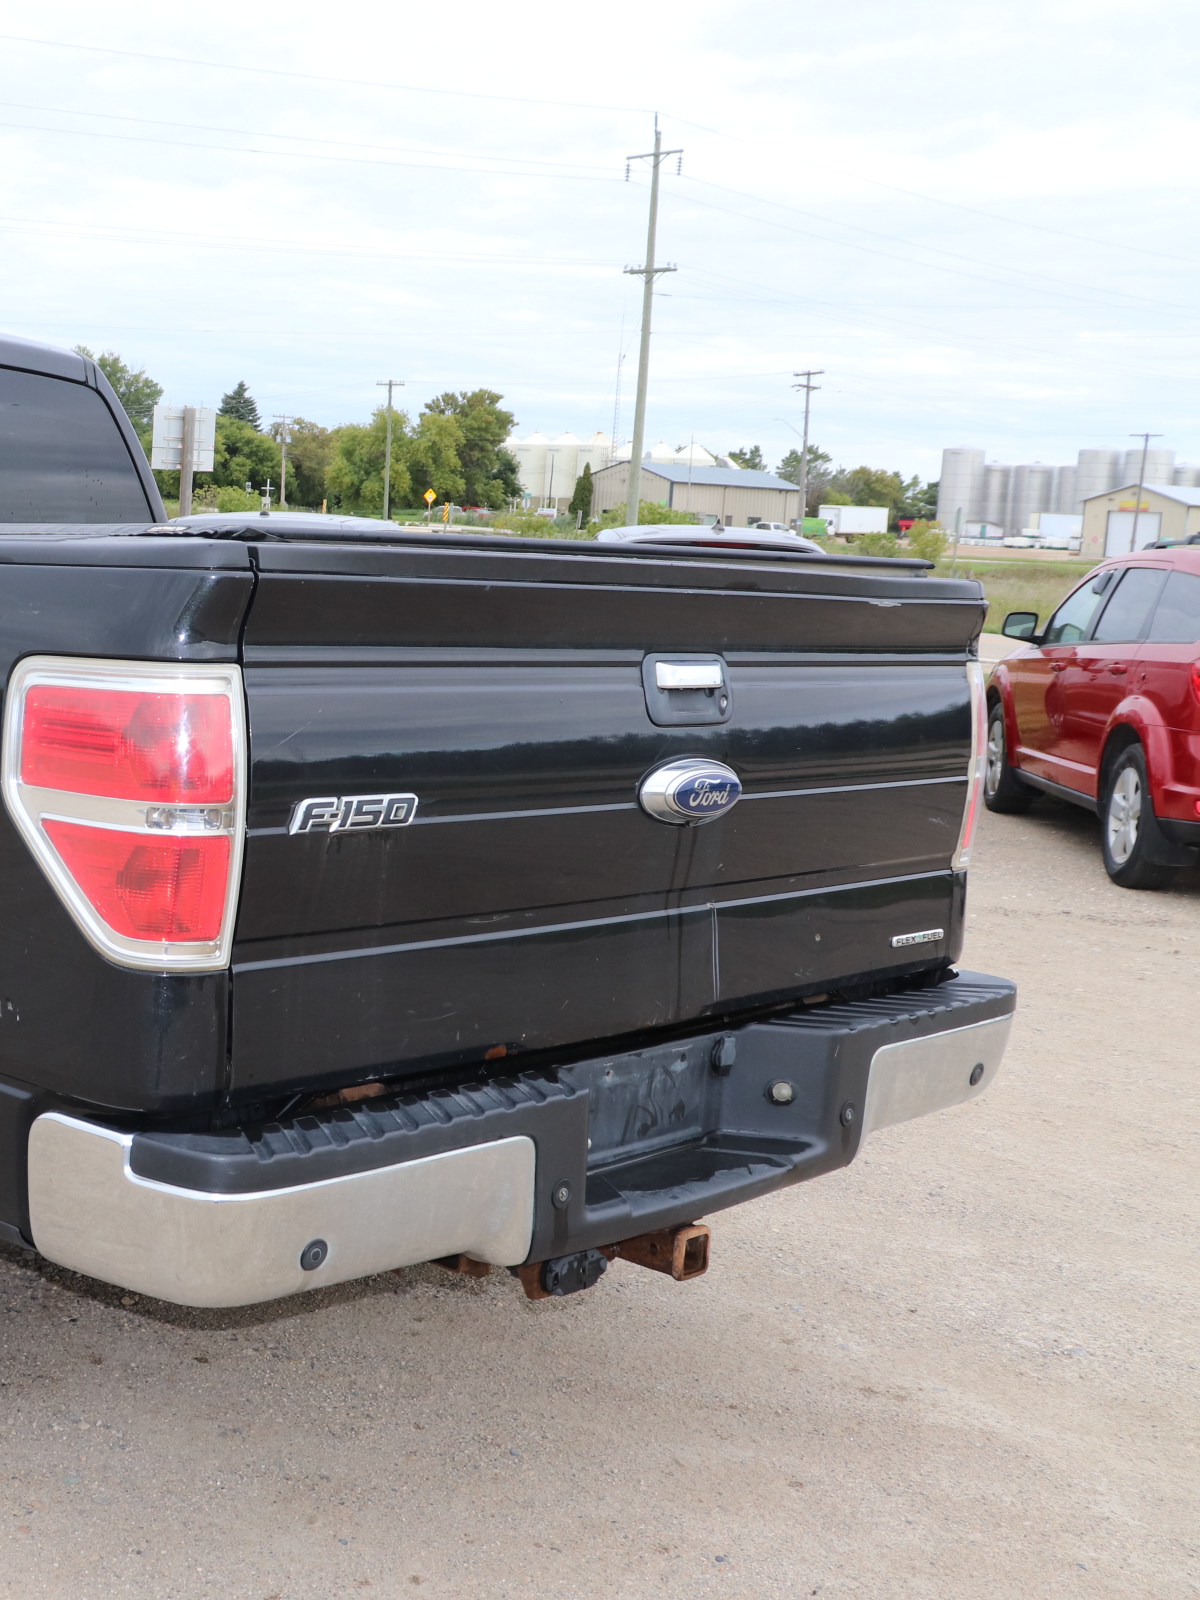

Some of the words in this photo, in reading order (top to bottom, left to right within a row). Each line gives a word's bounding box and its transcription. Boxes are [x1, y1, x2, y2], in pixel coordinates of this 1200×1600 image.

[689, 778, 731, 807] Ford
[289, 793, 419, 835] F-150
[896, 935, 917, 946] FLEX
[922, 931, 943, 942] FUEL
